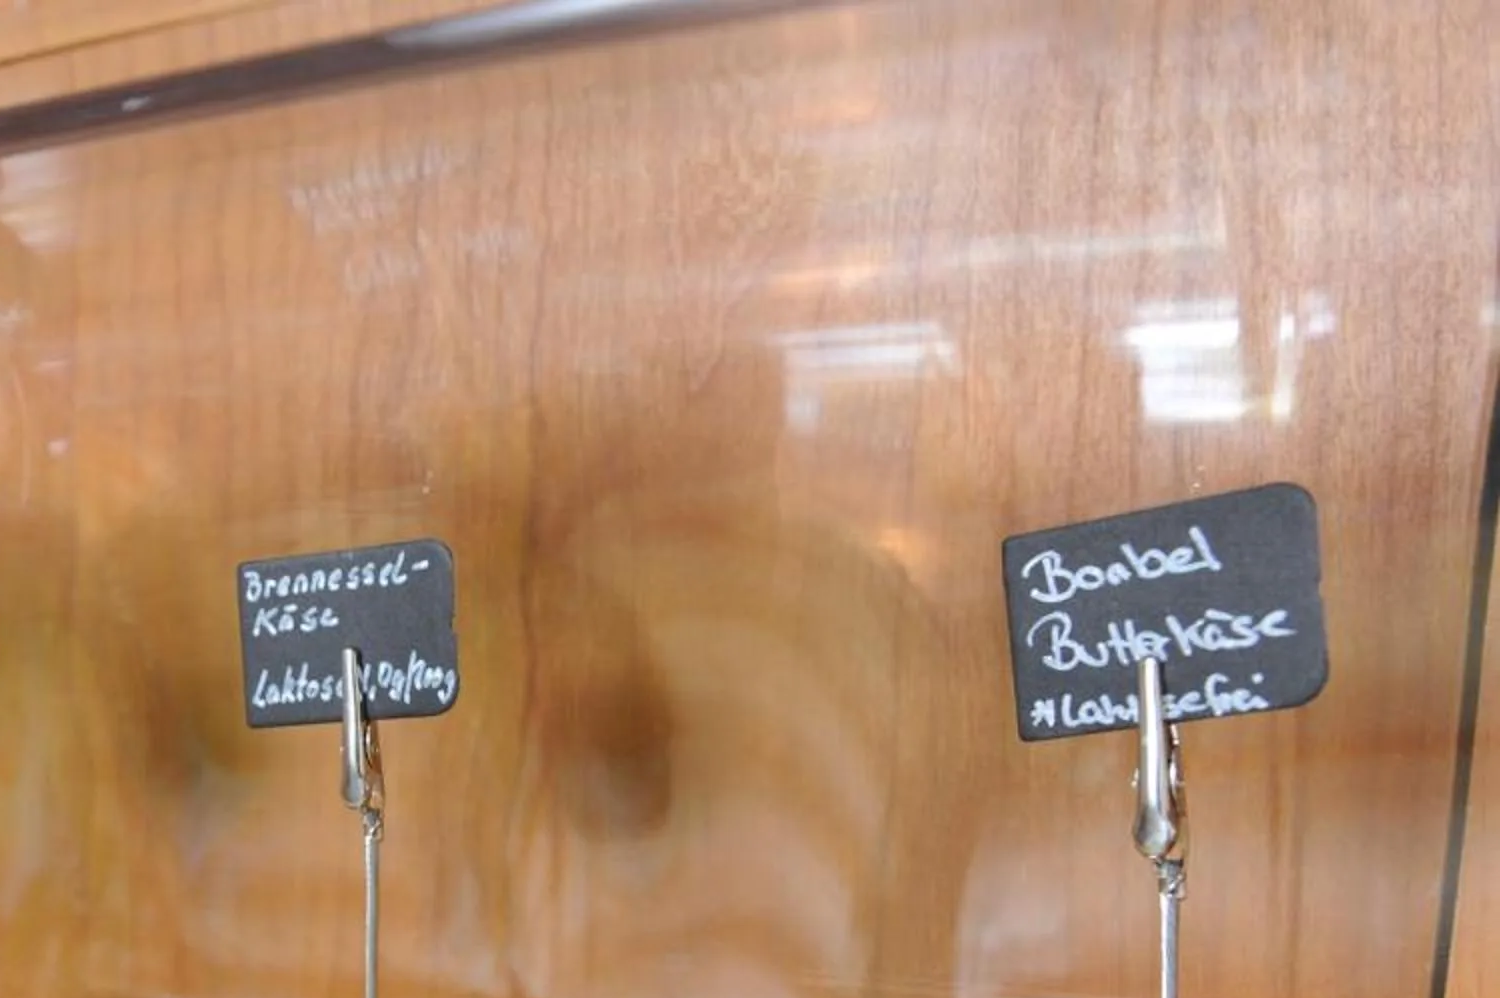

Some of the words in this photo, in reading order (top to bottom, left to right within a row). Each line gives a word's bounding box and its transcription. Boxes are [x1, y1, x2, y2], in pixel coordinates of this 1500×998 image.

[244, 550, 429, 602] Brennessel-
[1021, 525, 1222, 603] Bonbel
[252, 604, 339, 637] Käse
